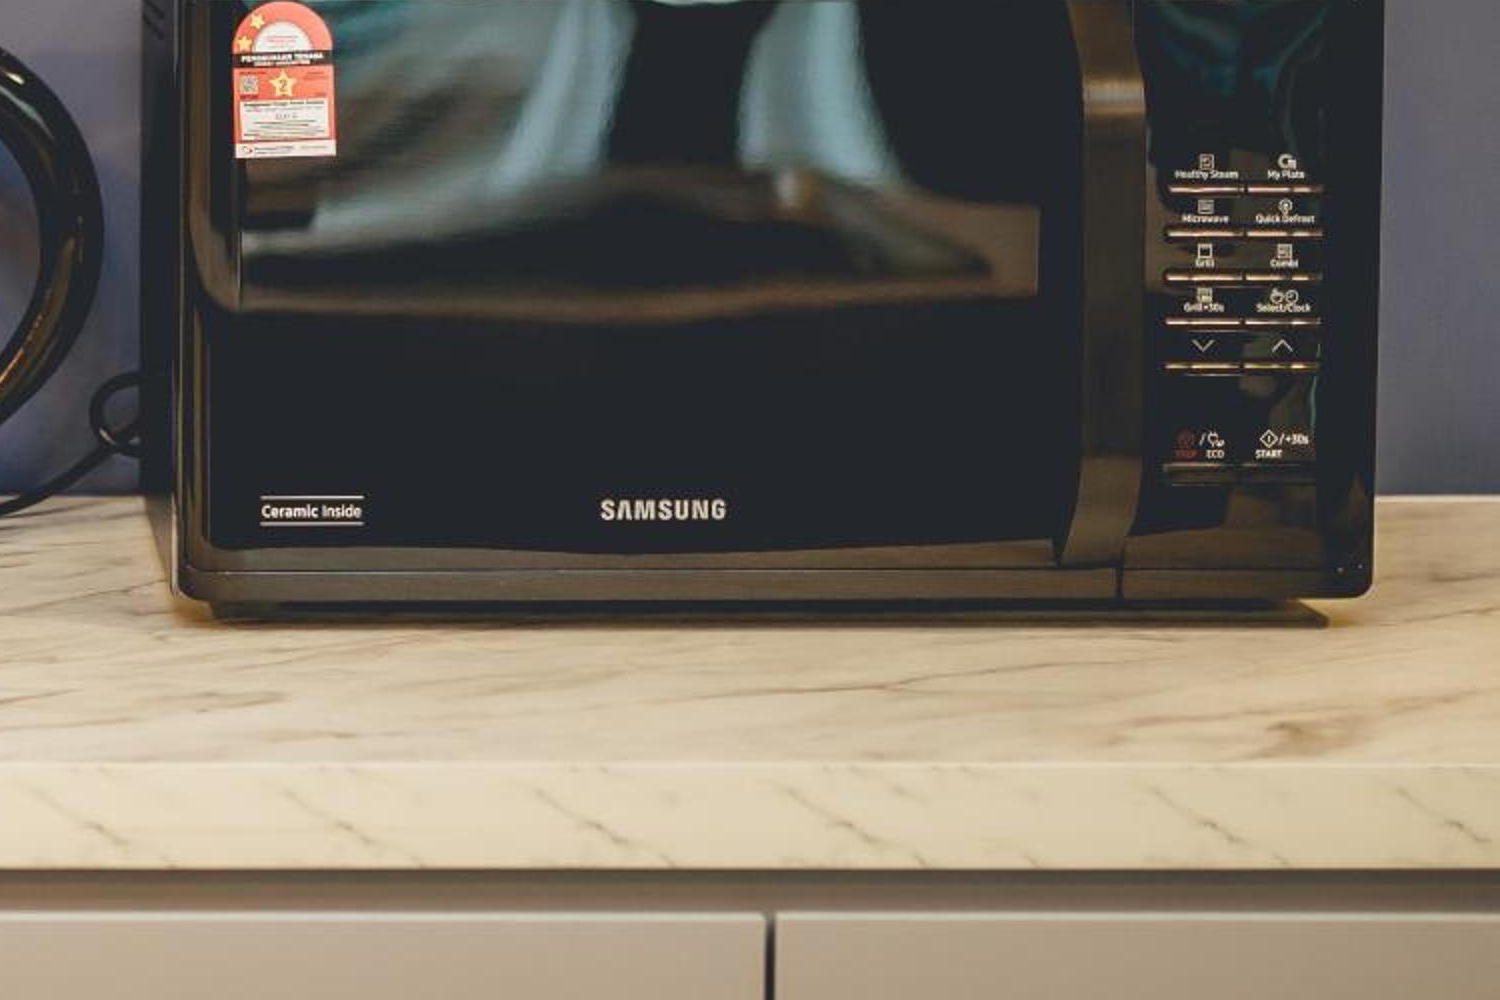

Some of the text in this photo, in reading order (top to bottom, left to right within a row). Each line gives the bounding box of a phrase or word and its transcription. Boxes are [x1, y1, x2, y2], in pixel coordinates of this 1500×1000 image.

[1210, 170, 1239, 179] Steam
[1267, 170, 1305, 180] My Plate
[1182, 214, 1229, 223] Microwave
[1255, 214, 1315, 223] Quick Defrost
[1206, 449, 1225, 459] ECO
[1255, 449, 1282, 459] START
[261, 503, 362, 519] Ceramic Inside
[600, 499, 727, 521] SAMSUNG
